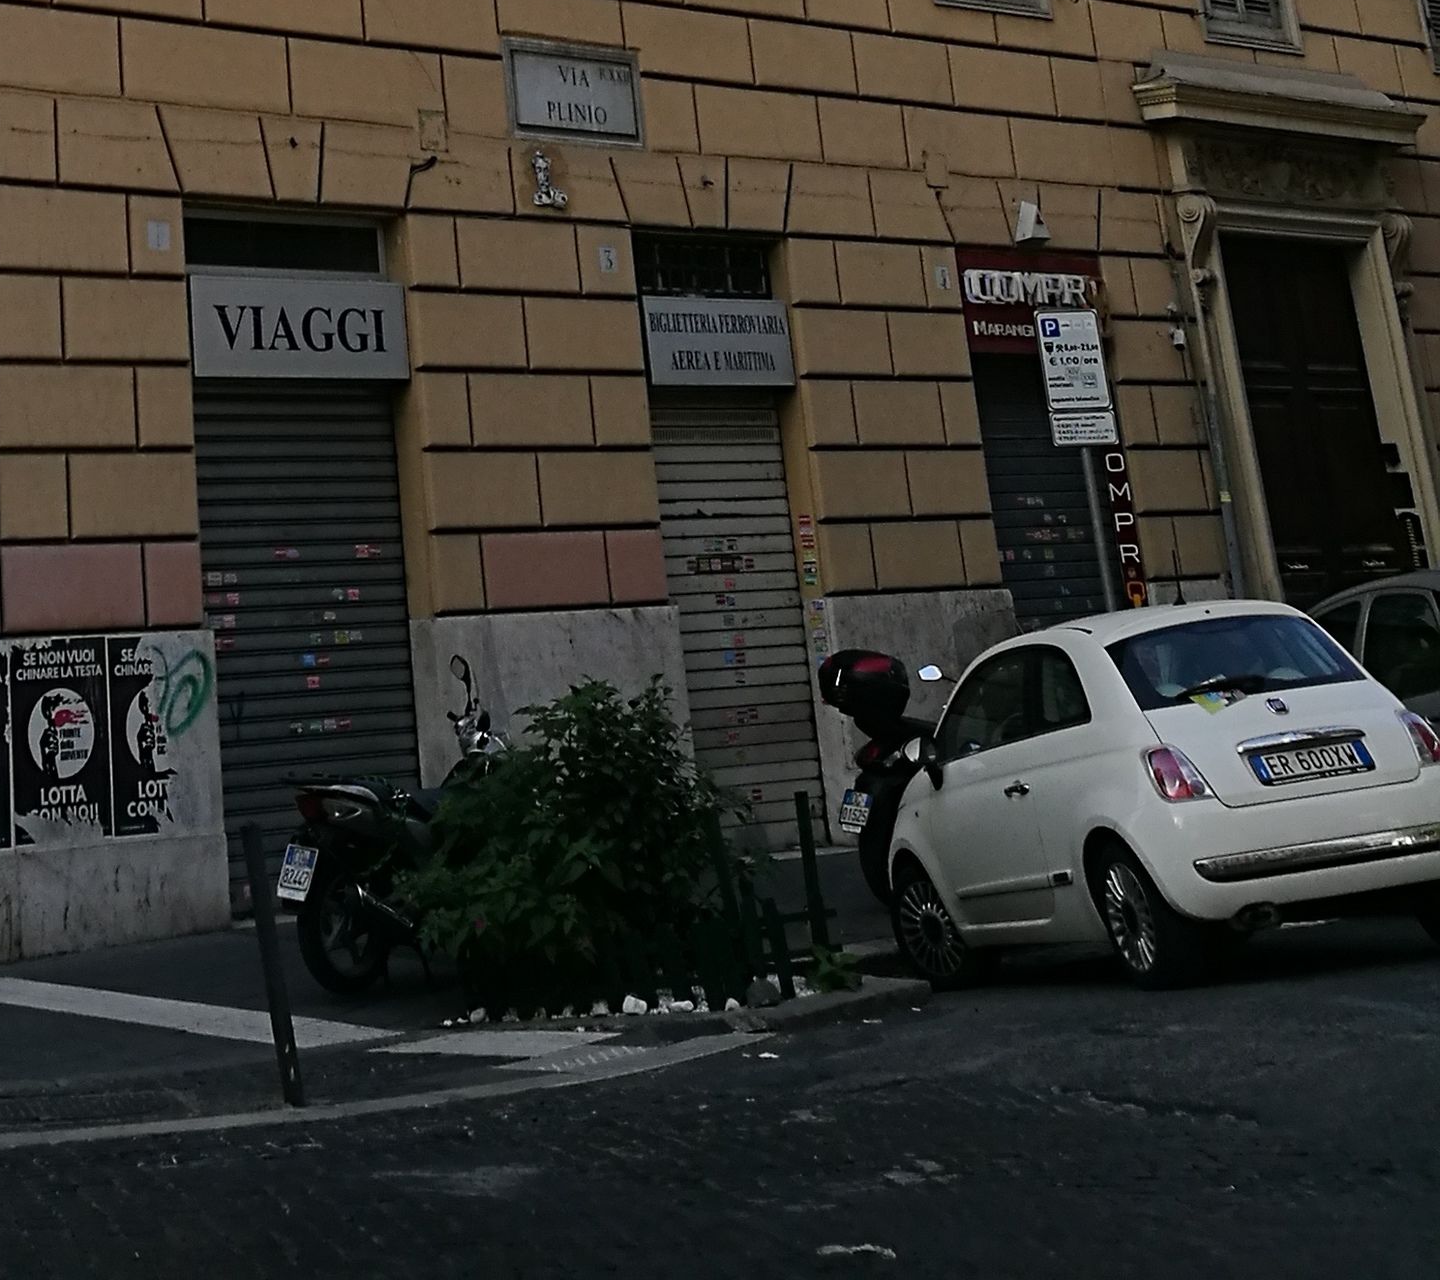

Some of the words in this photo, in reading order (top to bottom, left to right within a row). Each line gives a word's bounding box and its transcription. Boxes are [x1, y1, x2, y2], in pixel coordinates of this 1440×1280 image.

[558, 65, 590, 88] VIA
[547, 100, 607, 125] PLINIO
[213, 304, 387, 353] VIAGGI
[649, 312, 717, 334] BIGLIETTERIA
[719, 313, 786, 335] FERROVIARIA
[672, 350, 710, 371] AEREA
[714, 351, 721, 370] E
[724, 351, 775, 371] MARITTIMA
[23, 652, 37, 667] SE
[39, 650, 65, 665] NON
[66, 648, 95, 663] VUOI
[120, 648, 134, 663] SE
[15, 667, 59, 681] CHINARE
[60, 666, 74, 679] LA
[75, 663, 103, 677] TESTA
[1262, 754, 1294, 776] ER
[1295, 743, 1359, 771] 600XW
[40, 785, 87, 806] LOTTA
